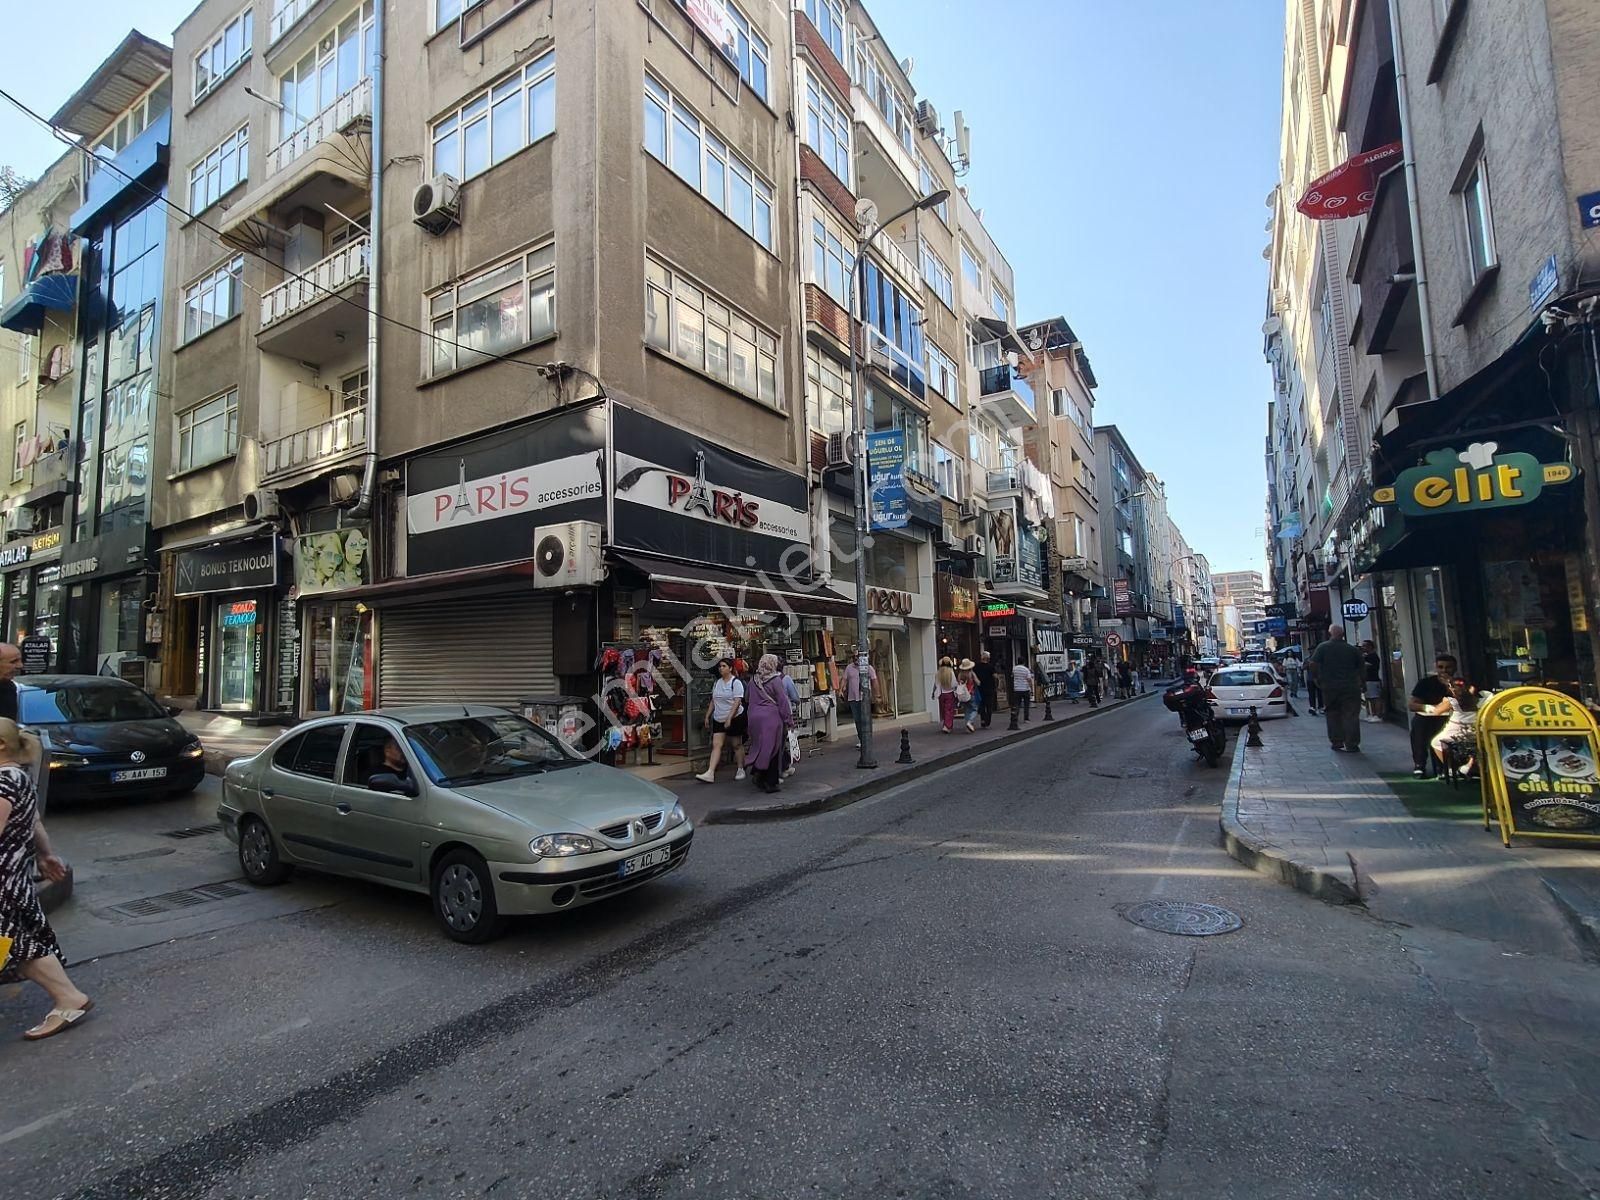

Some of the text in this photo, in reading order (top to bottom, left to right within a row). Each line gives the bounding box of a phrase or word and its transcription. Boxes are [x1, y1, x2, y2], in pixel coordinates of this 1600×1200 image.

[1364, 148, 1395, 164] ALGIDA
[537, 481, 601, 503] accessories
[1413, 464, 1522, 508] elit
[759, 521, 798, 537] accessories
[61, 557, 98, 579] SAMSUNG
[201, 562, 226, 577] BONUS
[1037, 630, 1064, 652] SATILIK
[1518, 699, 1573, 717] elit
[1518, 780, 1549, 793] elit
[624, 859, 636, 873] 55
